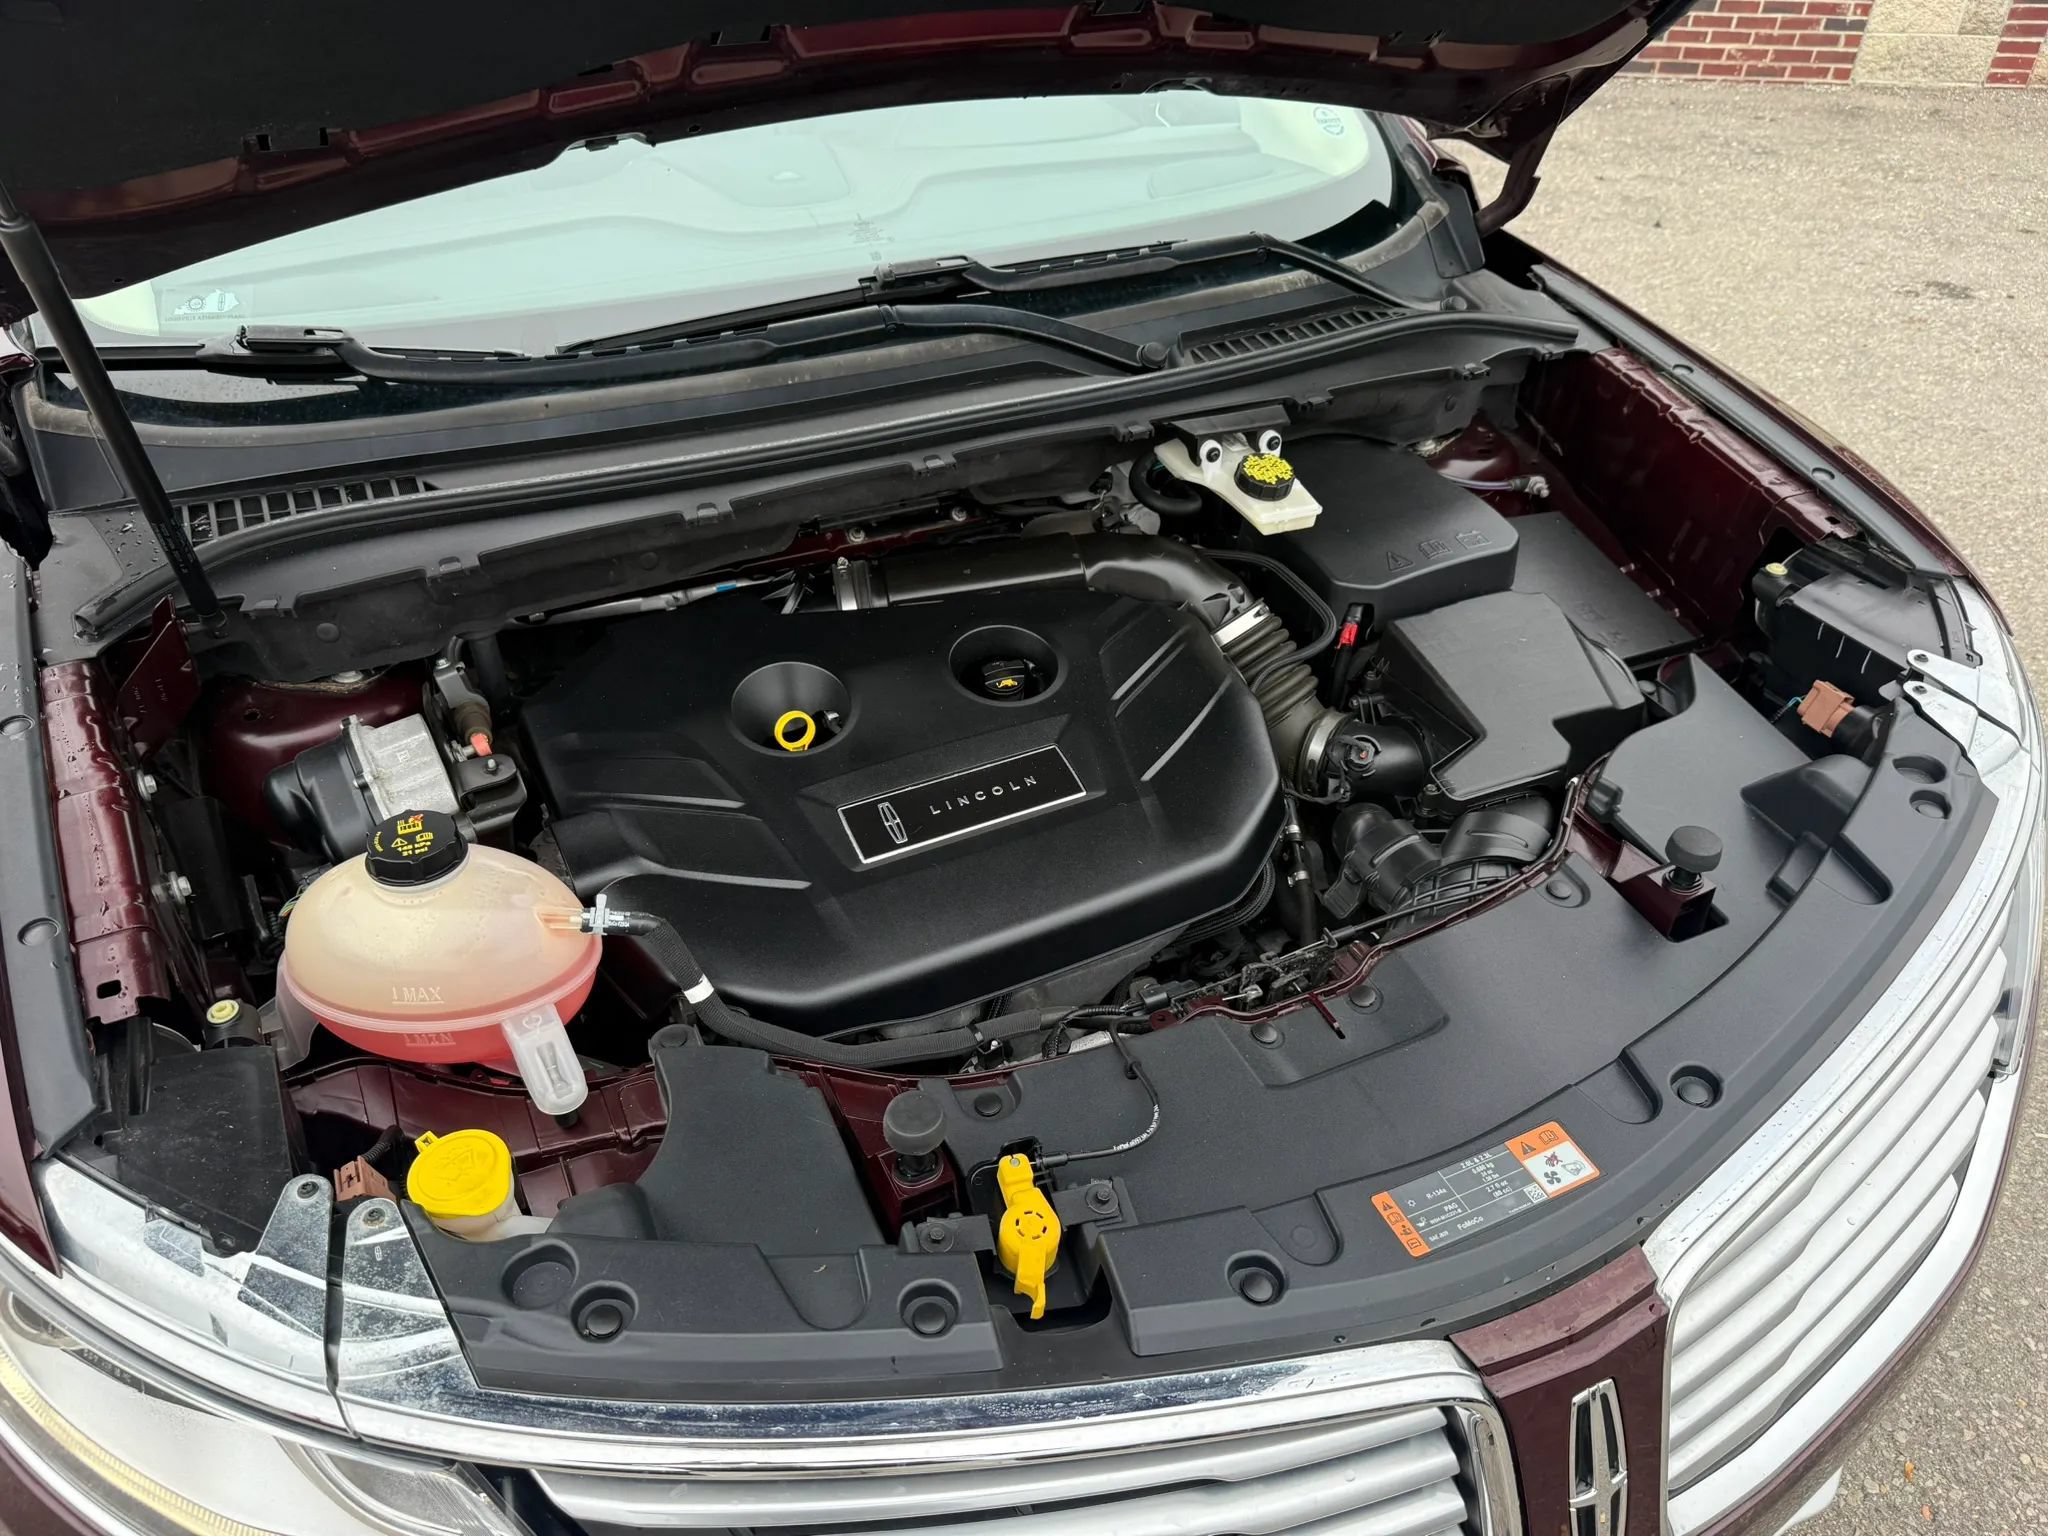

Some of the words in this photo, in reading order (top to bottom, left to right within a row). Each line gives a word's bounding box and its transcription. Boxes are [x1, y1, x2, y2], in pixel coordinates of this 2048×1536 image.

[929, 775, 1037, 815] LINCOLN
[402, 986, 441, 1001] MAX
[1443, 1202, 1458, 1212] PAG
[1457, 1216, 1484, 1230] FoMoCo
